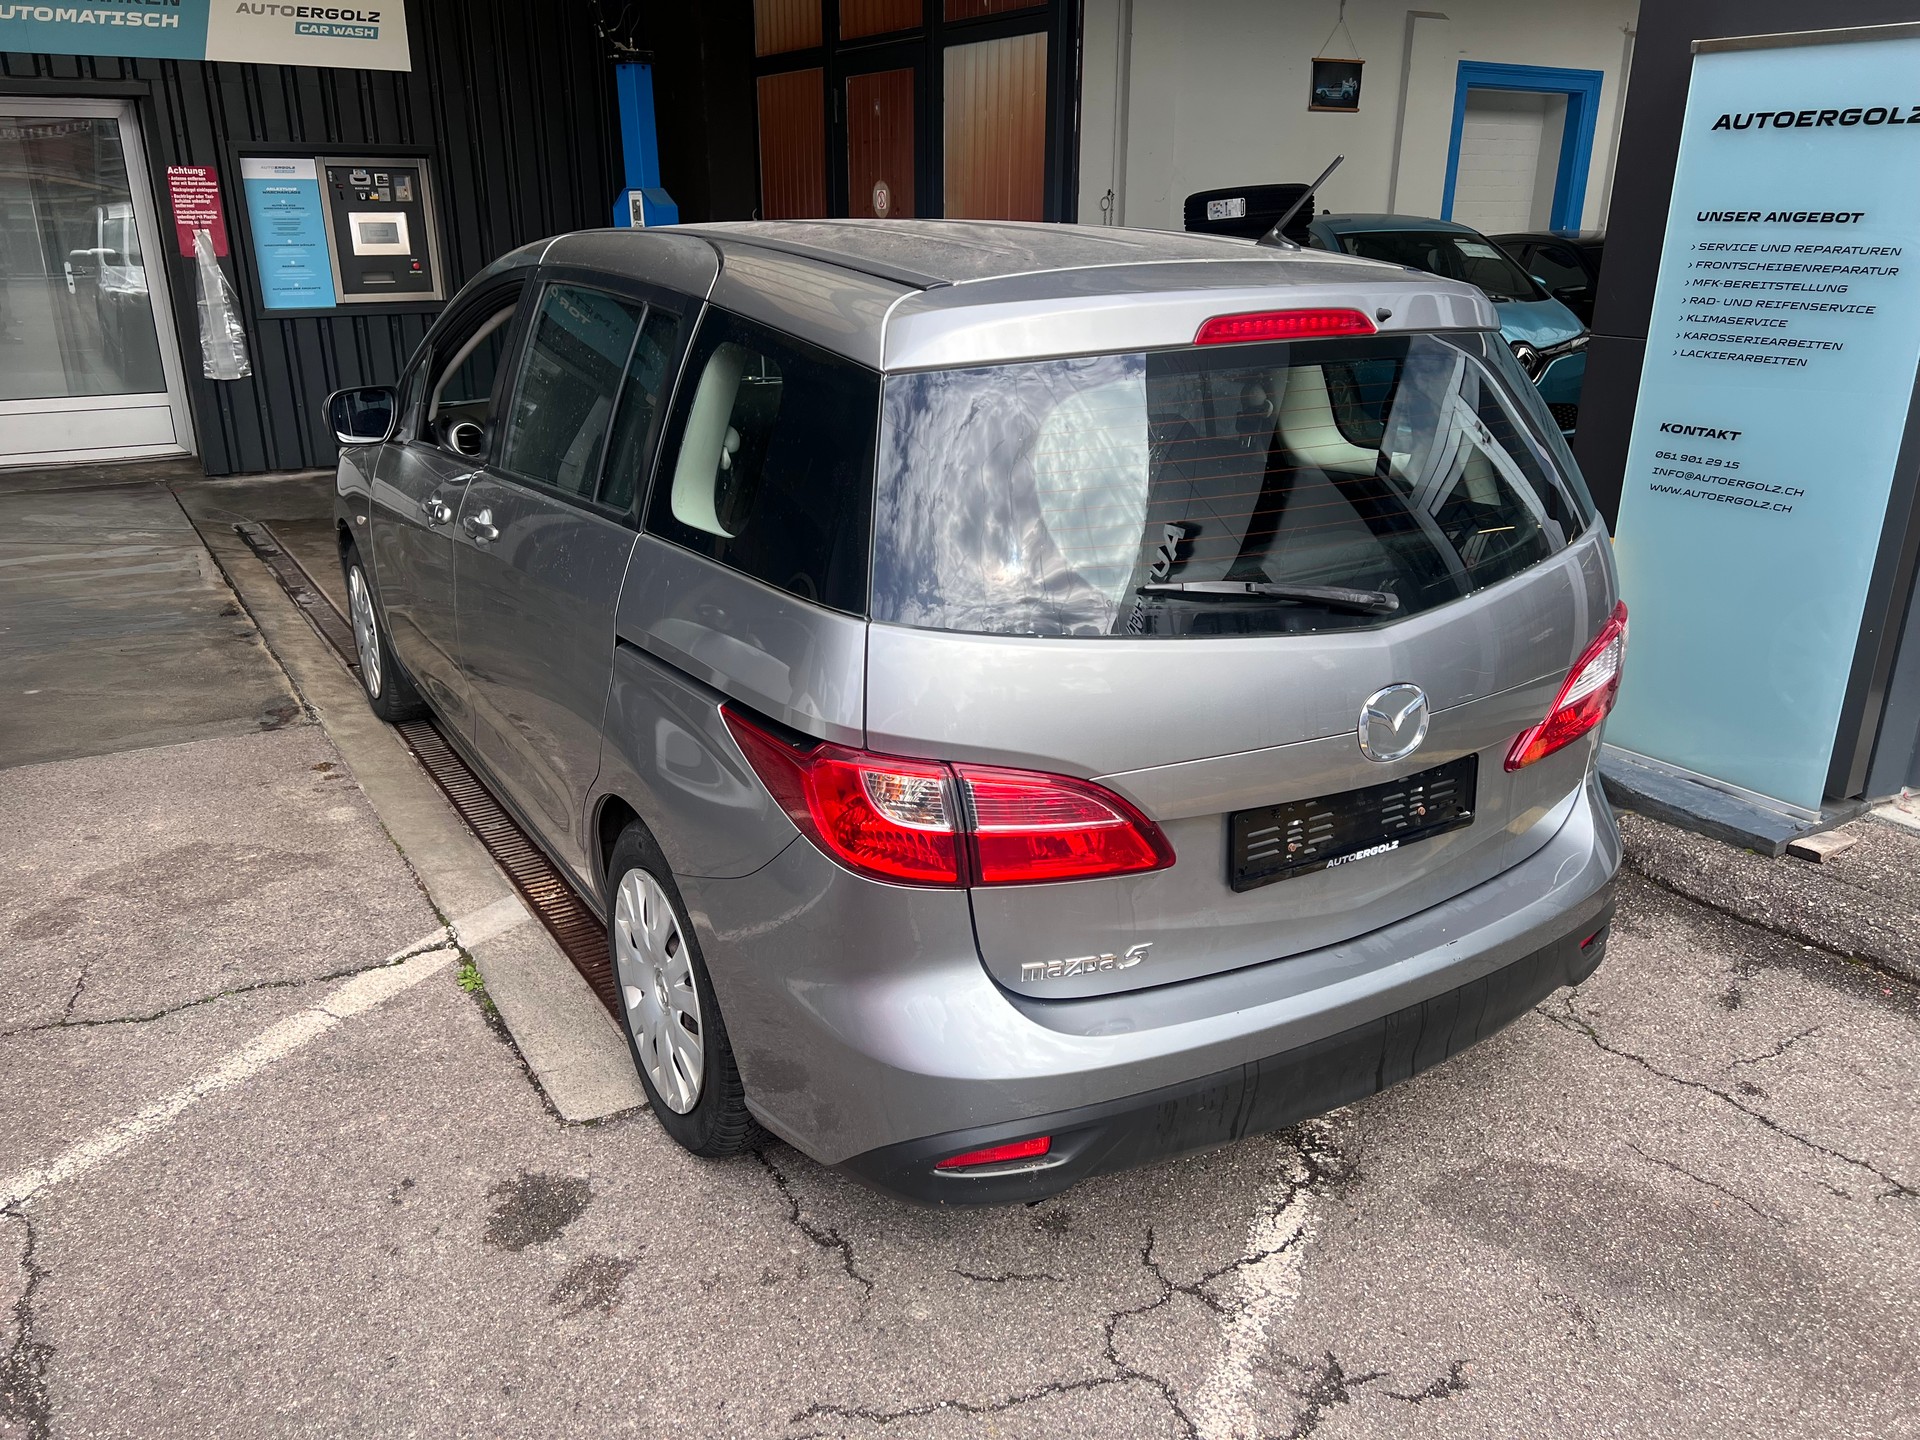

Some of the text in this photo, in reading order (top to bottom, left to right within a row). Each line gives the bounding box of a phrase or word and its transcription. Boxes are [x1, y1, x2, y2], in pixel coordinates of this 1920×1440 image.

[236, 3, 381, 23] AUTOERGOLZ
[299, 24, 374, 38] CAR WASH
[1711, 106, 1920, 131] AUTOERGOLZ
[167, 166, 206, 176] Achtung:
[1696, 211, 1865, 224] UNSER ANGEBOT
[1698, 243, 1902, 256] SERVICE UND REPARATUREN
[1695, 261, 1899, 277] FRONTSCHEIBENREPARATUR
[1692, 279, 1849, 294] MFK-BEREITSTELLUNG
[1689, 296, 1876, 315] RAD- UND REIFENSERVICE
[1686, 314, 1789, 328] KLIMASERVICE
[1683, 331, 1844, 351] KAROSSERIEARBEITEN
[1680, 349, 1808, 367] LACKIERARBEITEN
[1659, 422, 1742, 441] KONTAKT
[1655, 451, 1740, 469] 061 901 29 15
[1652, 467, 1805, 497] INFO@AUTOERGOLZ.CH
[1650, 483, 1793, 513] WWW.AUTOERGOLZ.CH
[1326, 840, 1399, 869] AUTOERGOLZ
